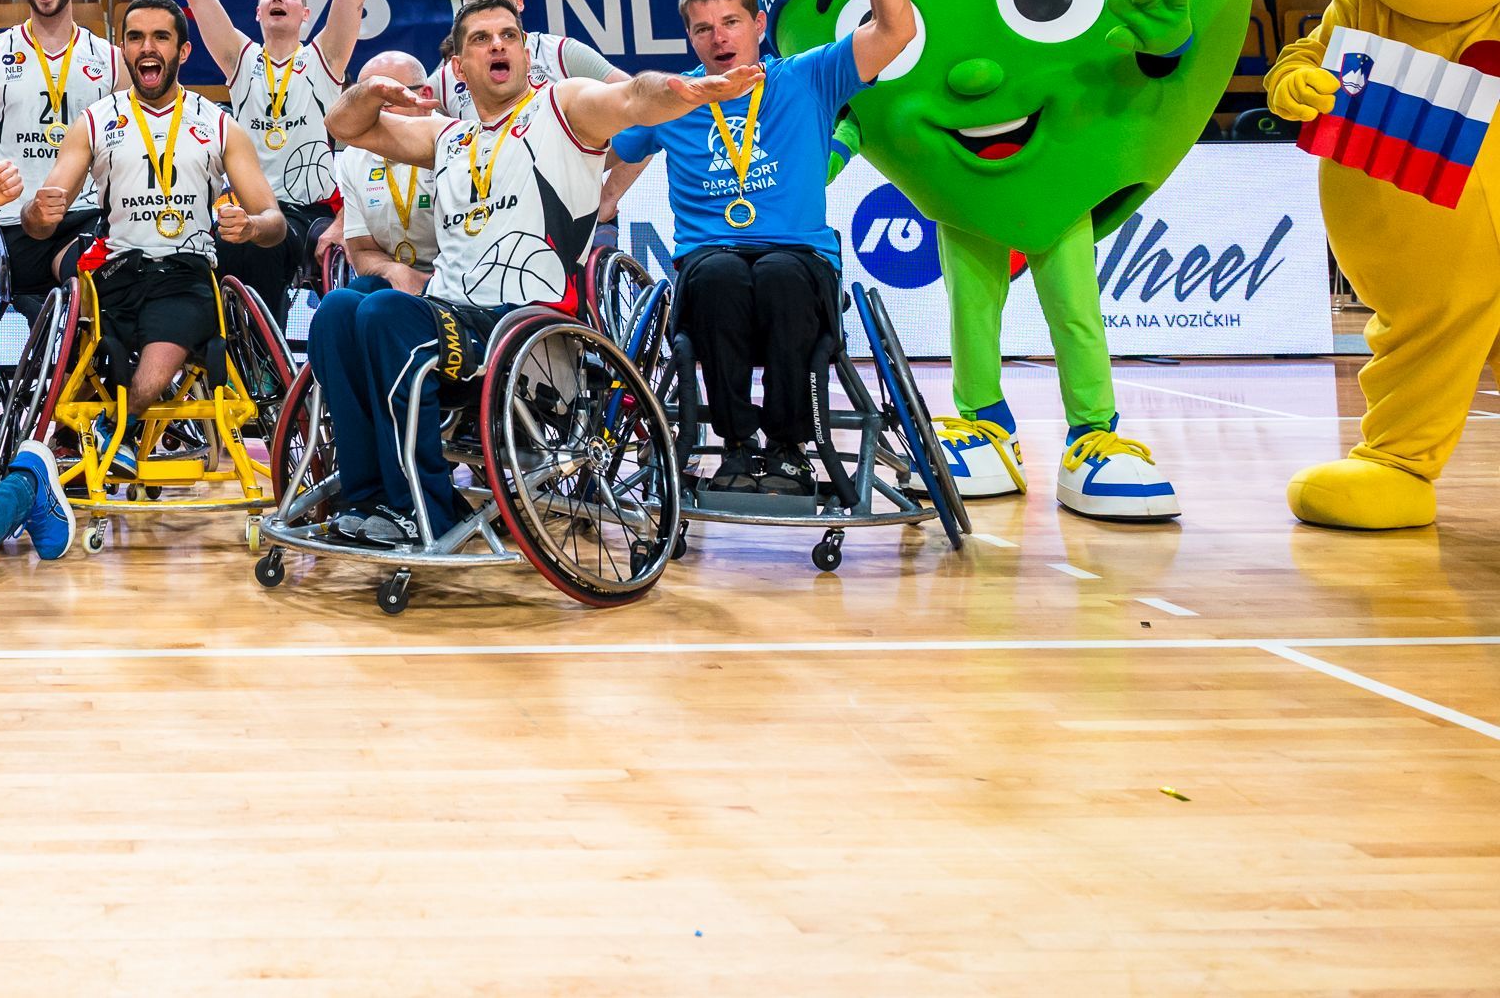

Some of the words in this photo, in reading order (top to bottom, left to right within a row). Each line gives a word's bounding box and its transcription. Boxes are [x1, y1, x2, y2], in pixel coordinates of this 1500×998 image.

[5, 65, 23, 74] NLB
[39, 91, 68, 125] 21
[16, 132, 65, 144] PARASP
[702, 161, 779, 191] PARAPORT
[122, 194, 197, 208] PARASPORT
[1136, 314, 1160, 328] NA
[1165, 311, 1241, 328] VOZIČKIH
